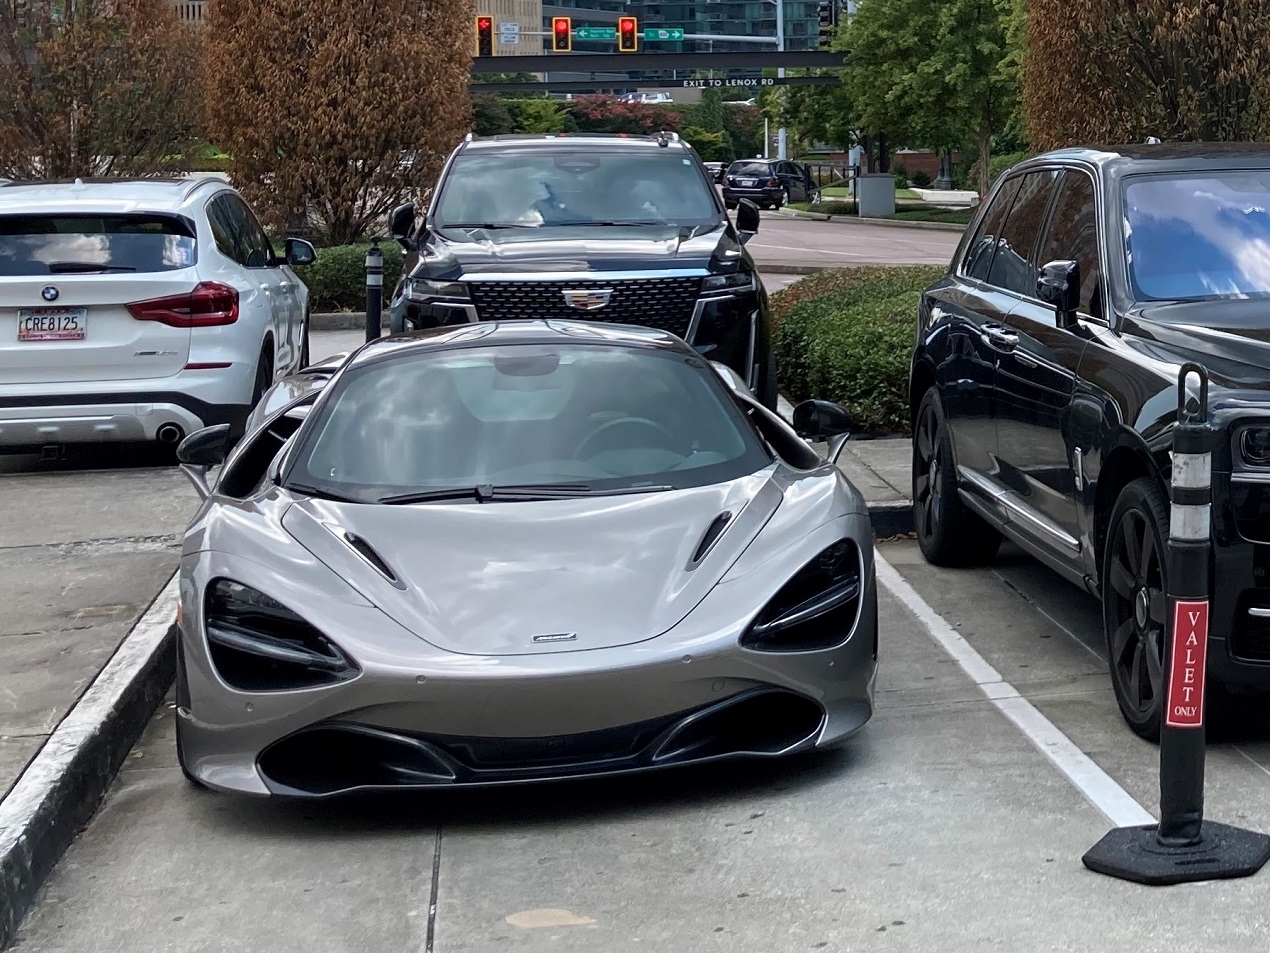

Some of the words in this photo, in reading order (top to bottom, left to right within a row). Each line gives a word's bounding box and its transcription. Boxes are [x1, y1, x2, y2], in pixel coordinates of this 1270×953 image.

[25, 316, 78, 331] CRE8125
[1182, 611, 1200, 702] VALET
[1174, 706, 1198, 716] ONLY
